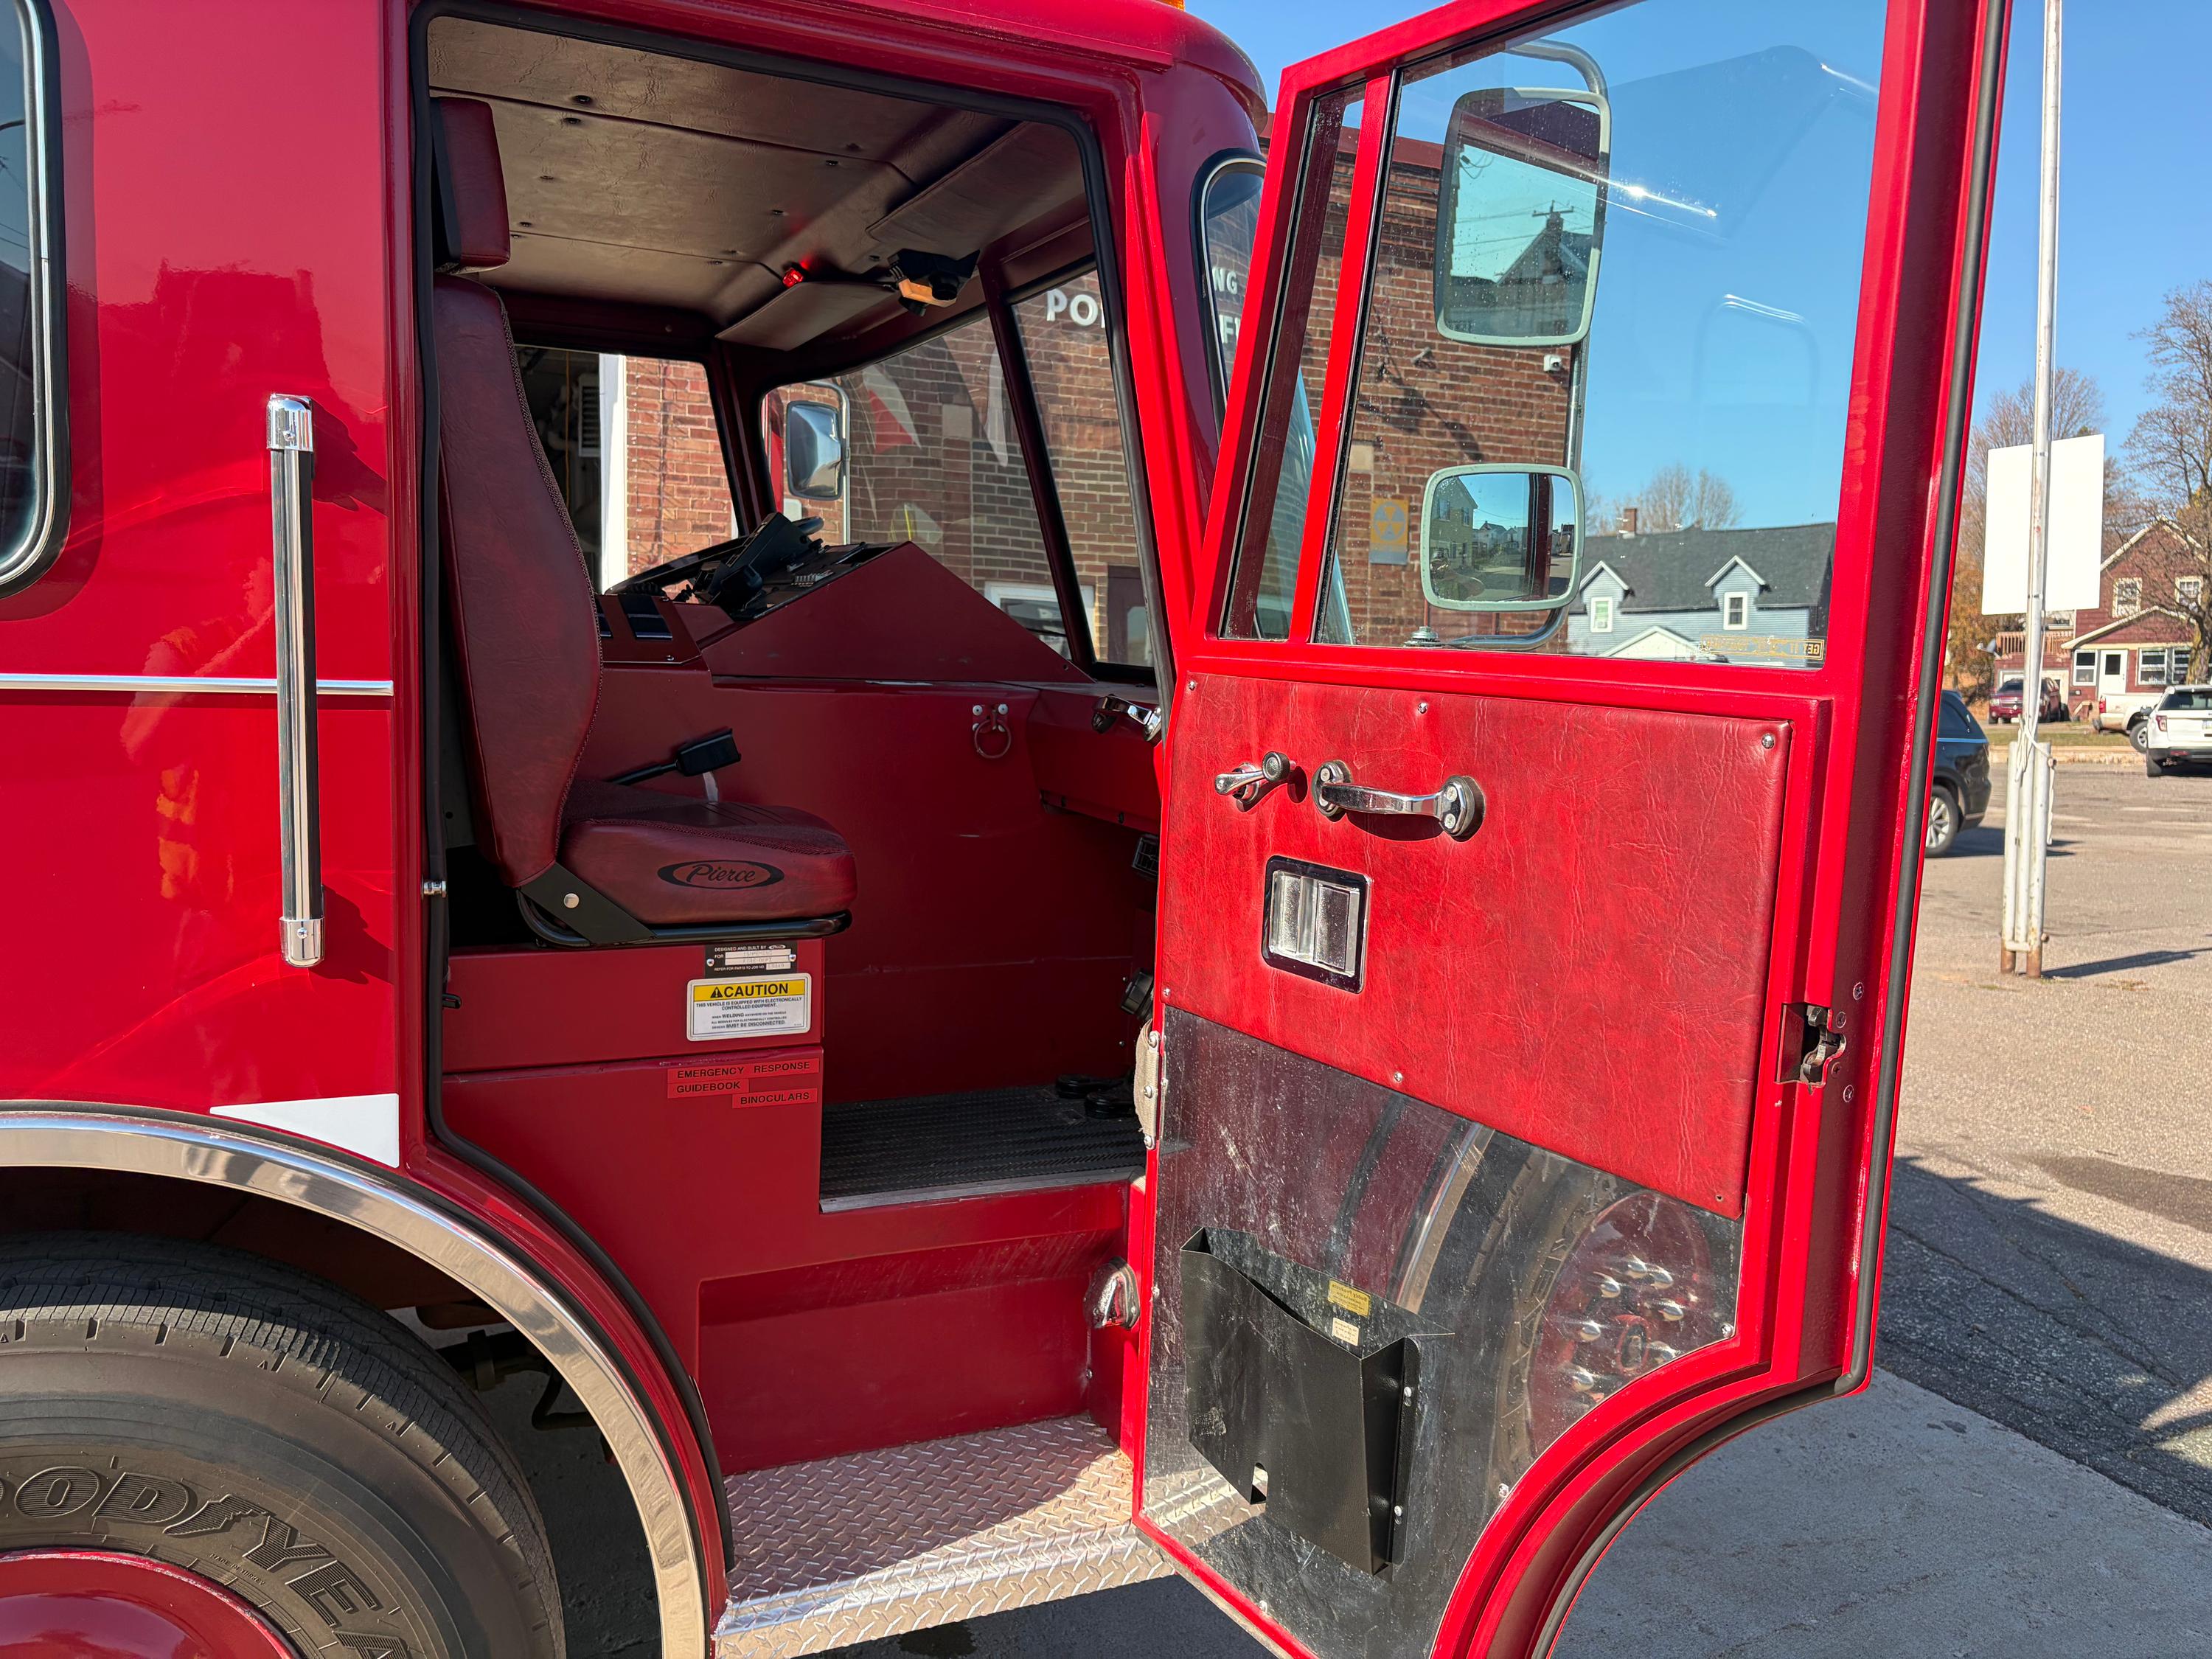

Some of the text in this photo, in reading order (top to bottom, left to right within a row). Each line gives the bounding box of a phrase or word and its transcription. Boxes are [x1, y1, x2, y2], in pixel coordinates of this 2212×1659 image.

[1046, 288, 1105, 330] PO
[686, 863, 756, 883] Pierce
[724, 983, 788, 997] CAUTION
[678, 1061, 810, 1079] EMERGENCY RESPONSE
[677, 1081, 741, 1093] GUIDEBOOK
[740, 1092, 810, 1105] BINOCULARS
[209, 1554, 229, 1565] MADE
